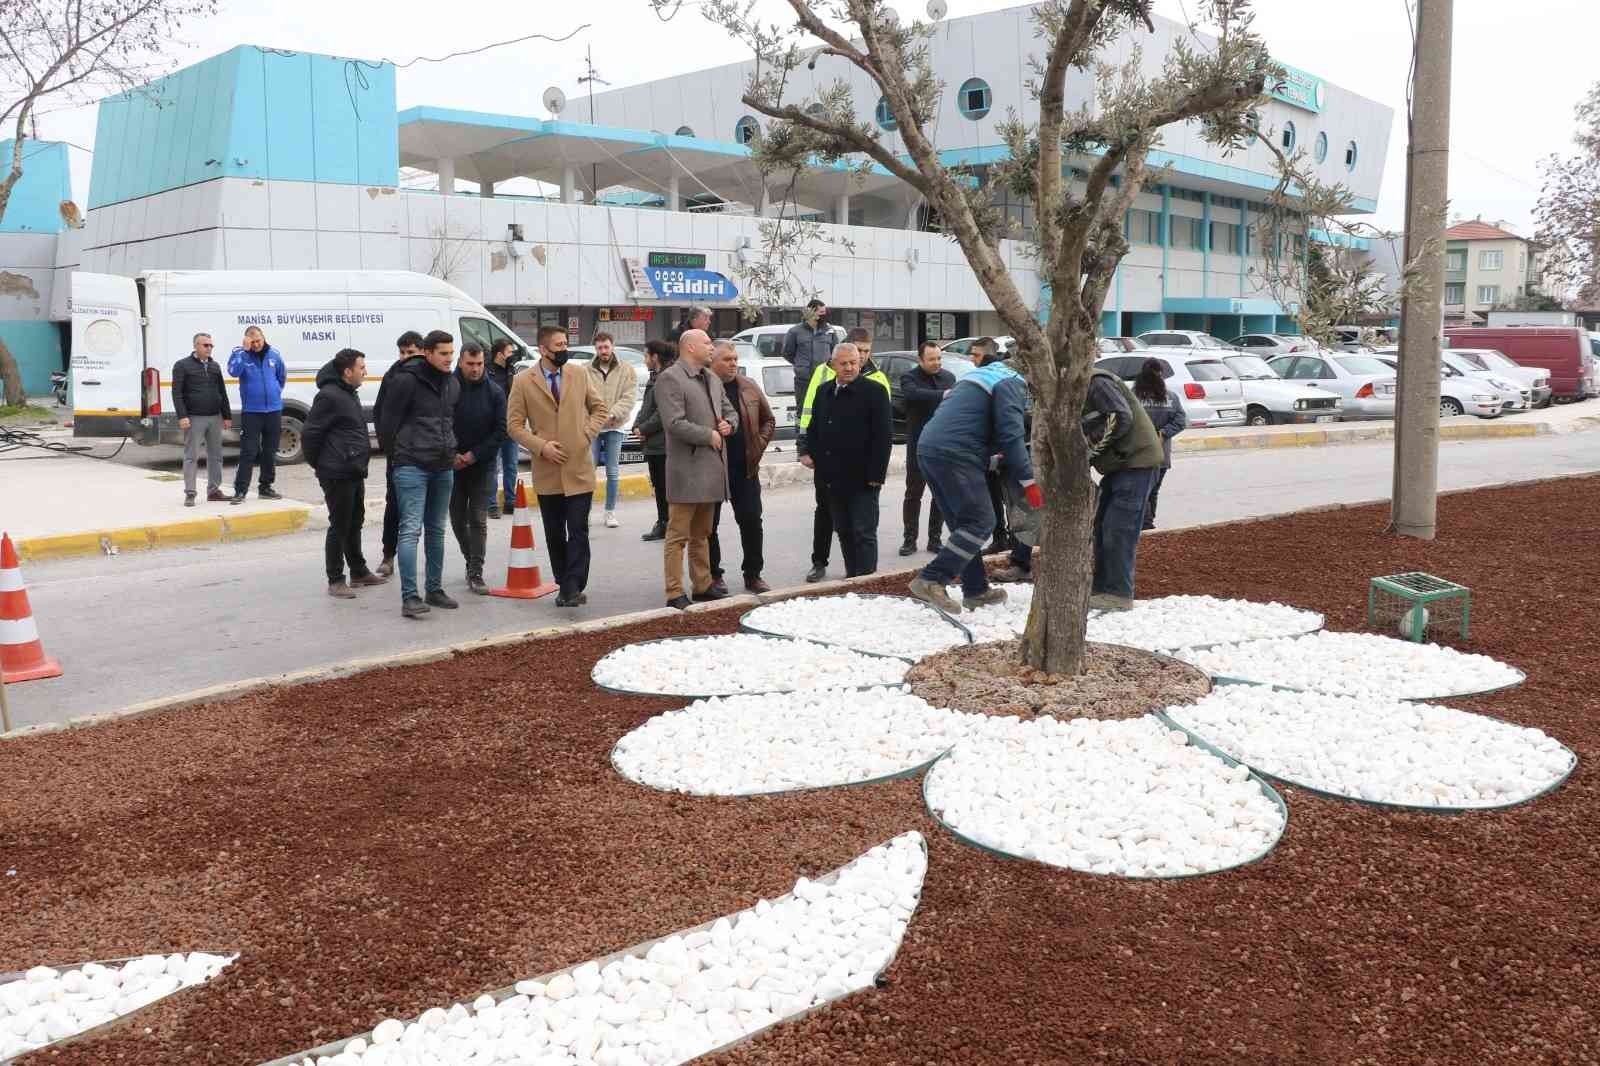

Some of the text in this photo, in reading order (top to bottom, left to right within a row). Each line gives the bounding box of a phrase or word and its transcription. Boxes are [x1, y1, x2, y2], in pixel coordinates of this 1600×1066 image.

[237, 312, 384, 326] MANİSA BÜYÜKŞEHİR BELEDİYESİ
[302, 329, 336, 341] MASKİ
